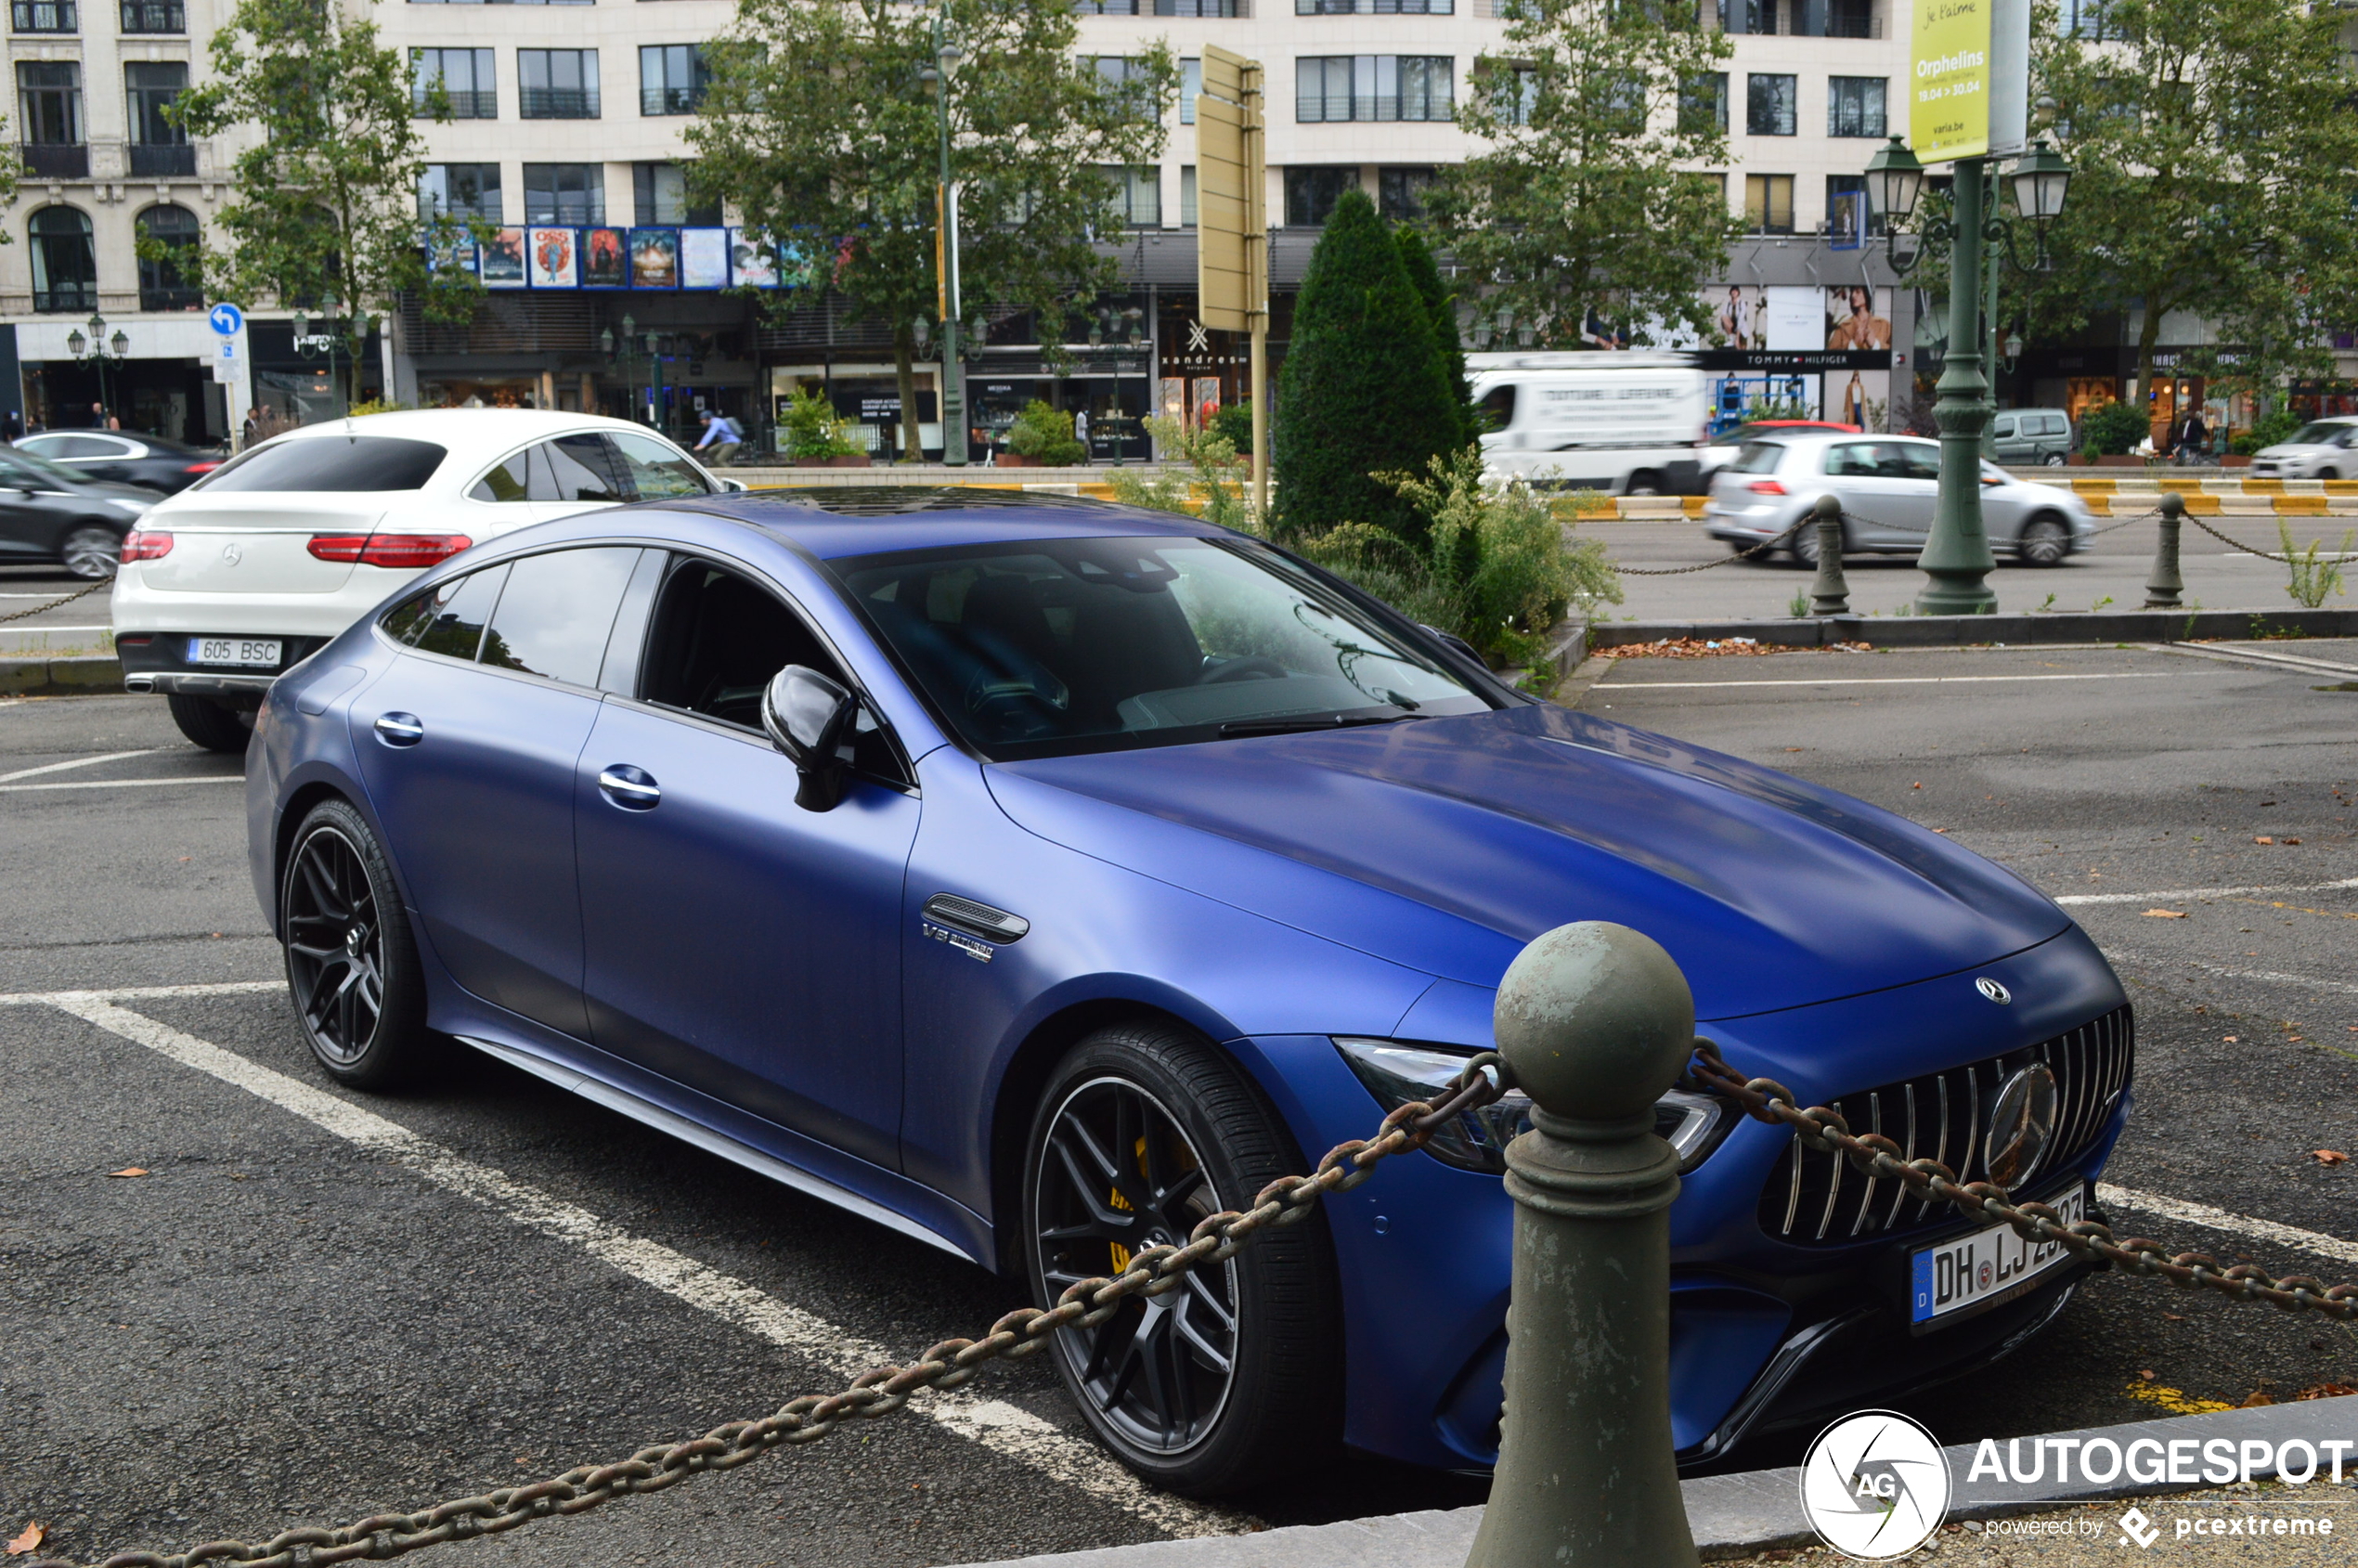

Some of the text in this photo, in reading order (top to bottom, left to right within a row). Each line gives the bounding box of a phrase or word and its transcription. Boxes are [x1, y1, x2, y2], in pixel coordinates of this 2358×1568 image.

[1923, 2, 1976, 31] je t'aime
[1916, 50, 1985, 78] Orphelins
[1918, 87, 1942, 102] 19.04
[1952, 80, 1980, 97] 30.04
[1933, 122, 1964, 135] varia.be
[535, 231, 569, 242] OSS
[1162, 355, 1236, 365] xandres
[1747, 356, 1847, 365] TOMMY HILFIGER
[203, 641, 276, 661] 605 BSC
[923, 923, 994, 955] V8 BITURBO
[1935, 1243, 1974, 1306] DH
[1996, 1232, 2028, 1283] LJ
[1918, 1292, 1927, 1308] D
